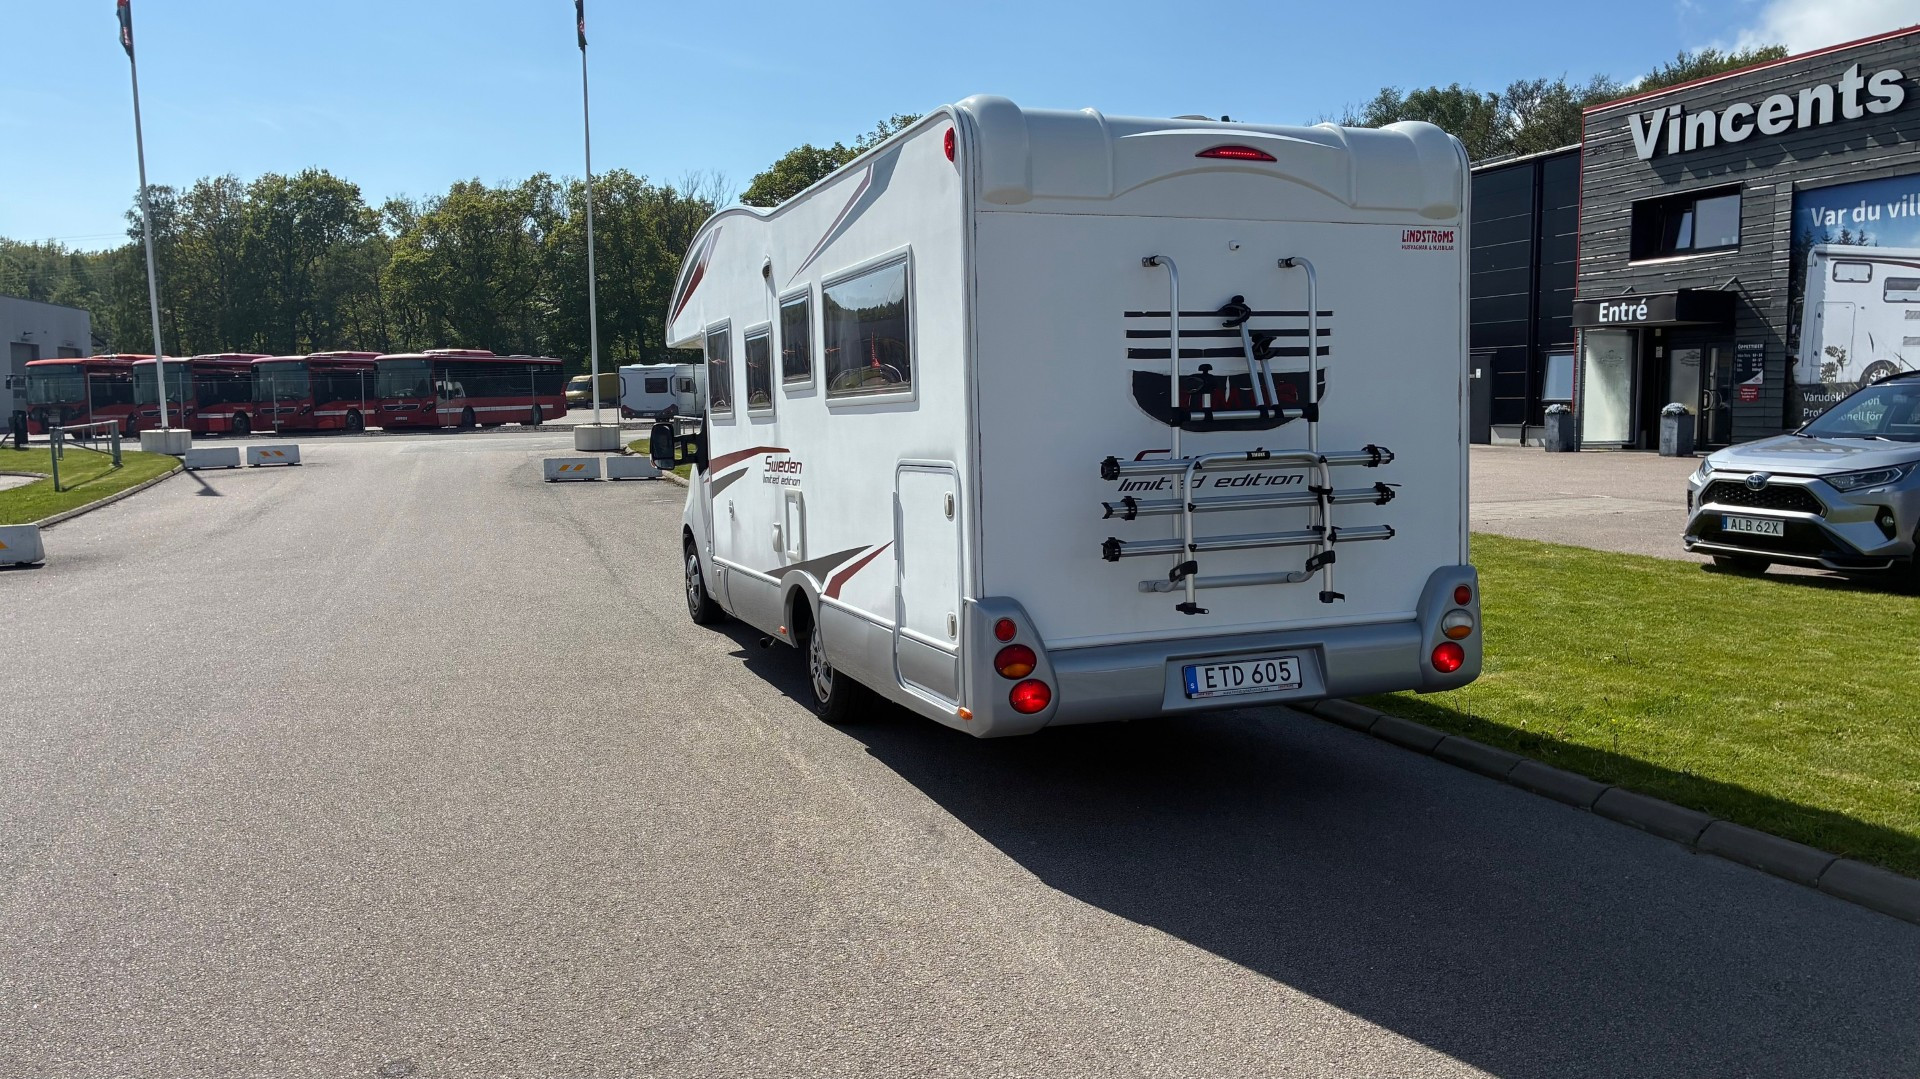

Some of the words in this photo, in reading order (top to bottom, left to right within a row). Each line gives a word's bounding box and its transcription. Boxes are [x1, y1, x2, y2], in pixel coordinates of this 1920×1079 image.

[1628, 62, 1905, 161] Vincents
[1810, 206, 1847, 227] Var
[1852, 200, 1880, 223] du
[1599, 298, 1648, 322] Entré
[764, 455, 803, 474] Sweden
[763, 474, 780, 485] limited
[780, 475, 801, 486] edition
[1117, 474, 1207, 492] limitd
[1214, 473, 1304, 488] edition
[1731, 519, 1752, 531] ALB
[1755, 521, 1778, 534] 62X
[1204, 666, 1244, 689] ETD
[1251, 661, 1292, 684] 605
